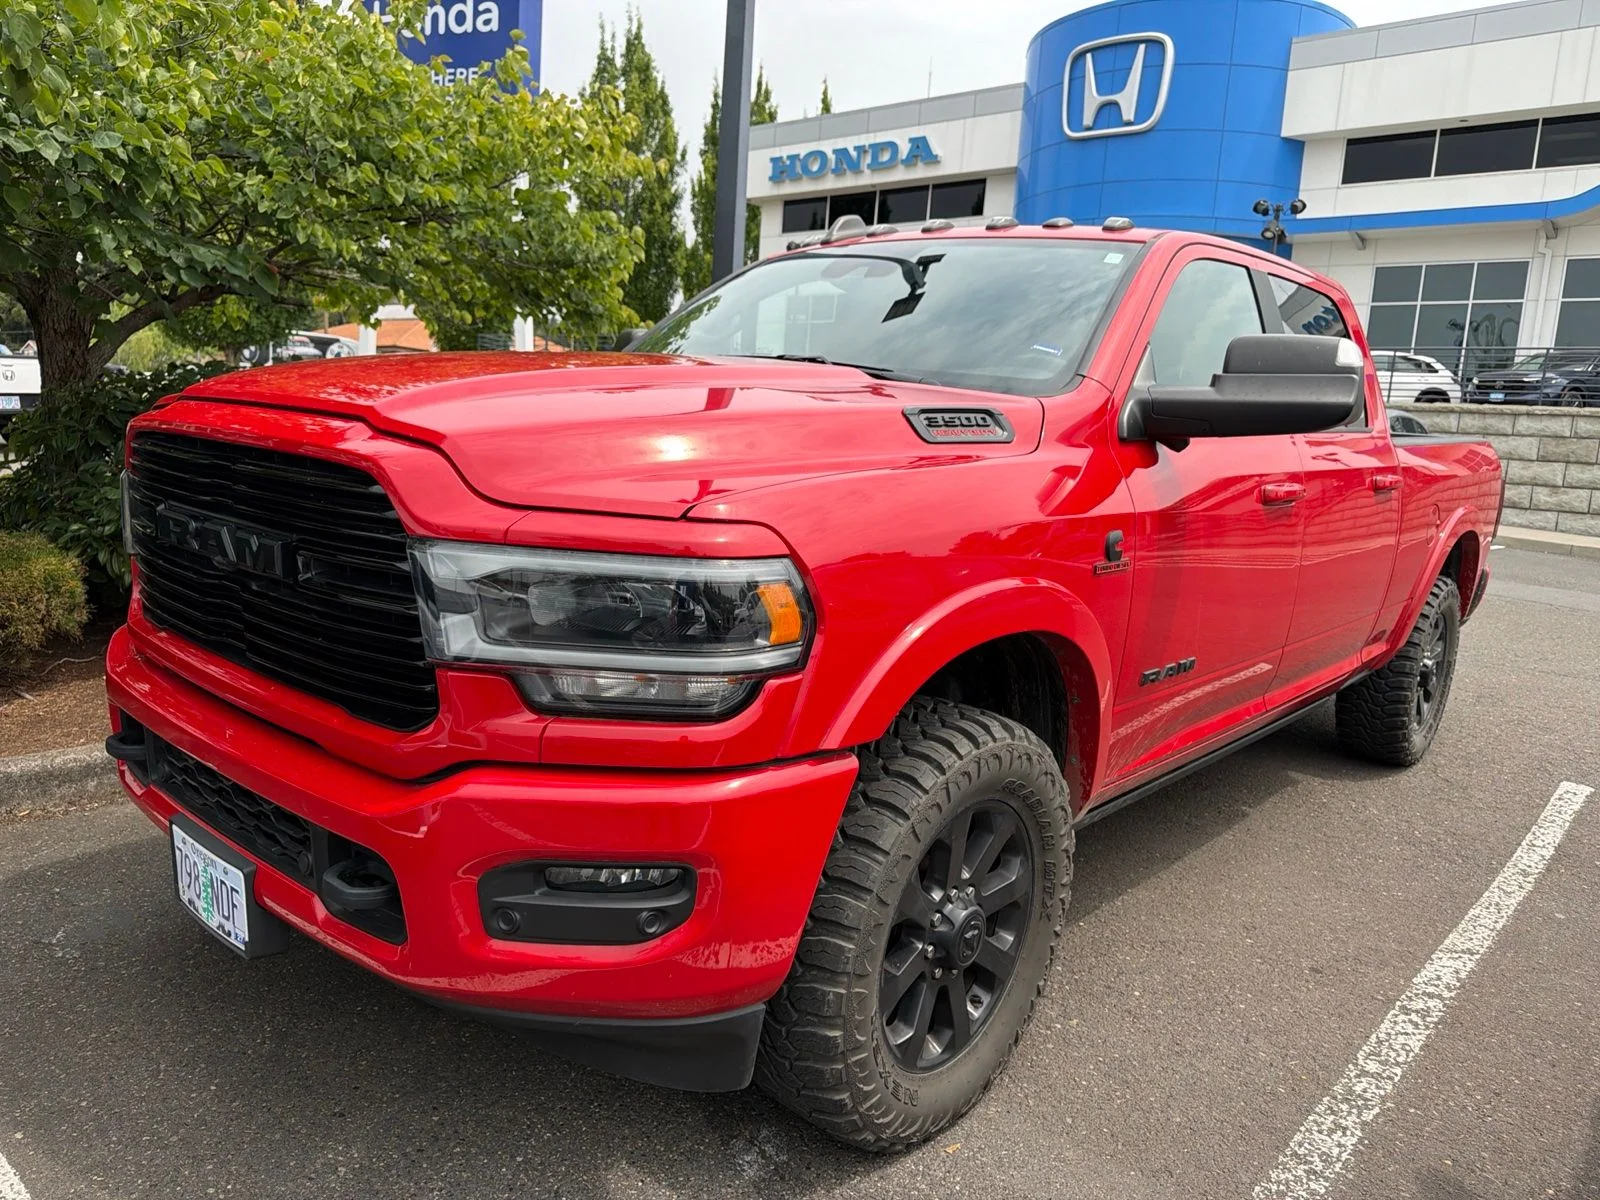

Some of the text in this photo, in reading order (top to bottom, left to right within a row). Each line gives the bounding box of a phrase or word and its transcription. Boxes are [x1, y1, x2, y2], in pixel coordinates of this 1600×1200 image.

[768, 135, 941, 183] HONDA
[922, 413, 991, 428] 3500
[157, 504, 292, 580] RAM
[1139, 657, 1196, 687] RAM
[175, 844, 241, 928] 798 NDF
